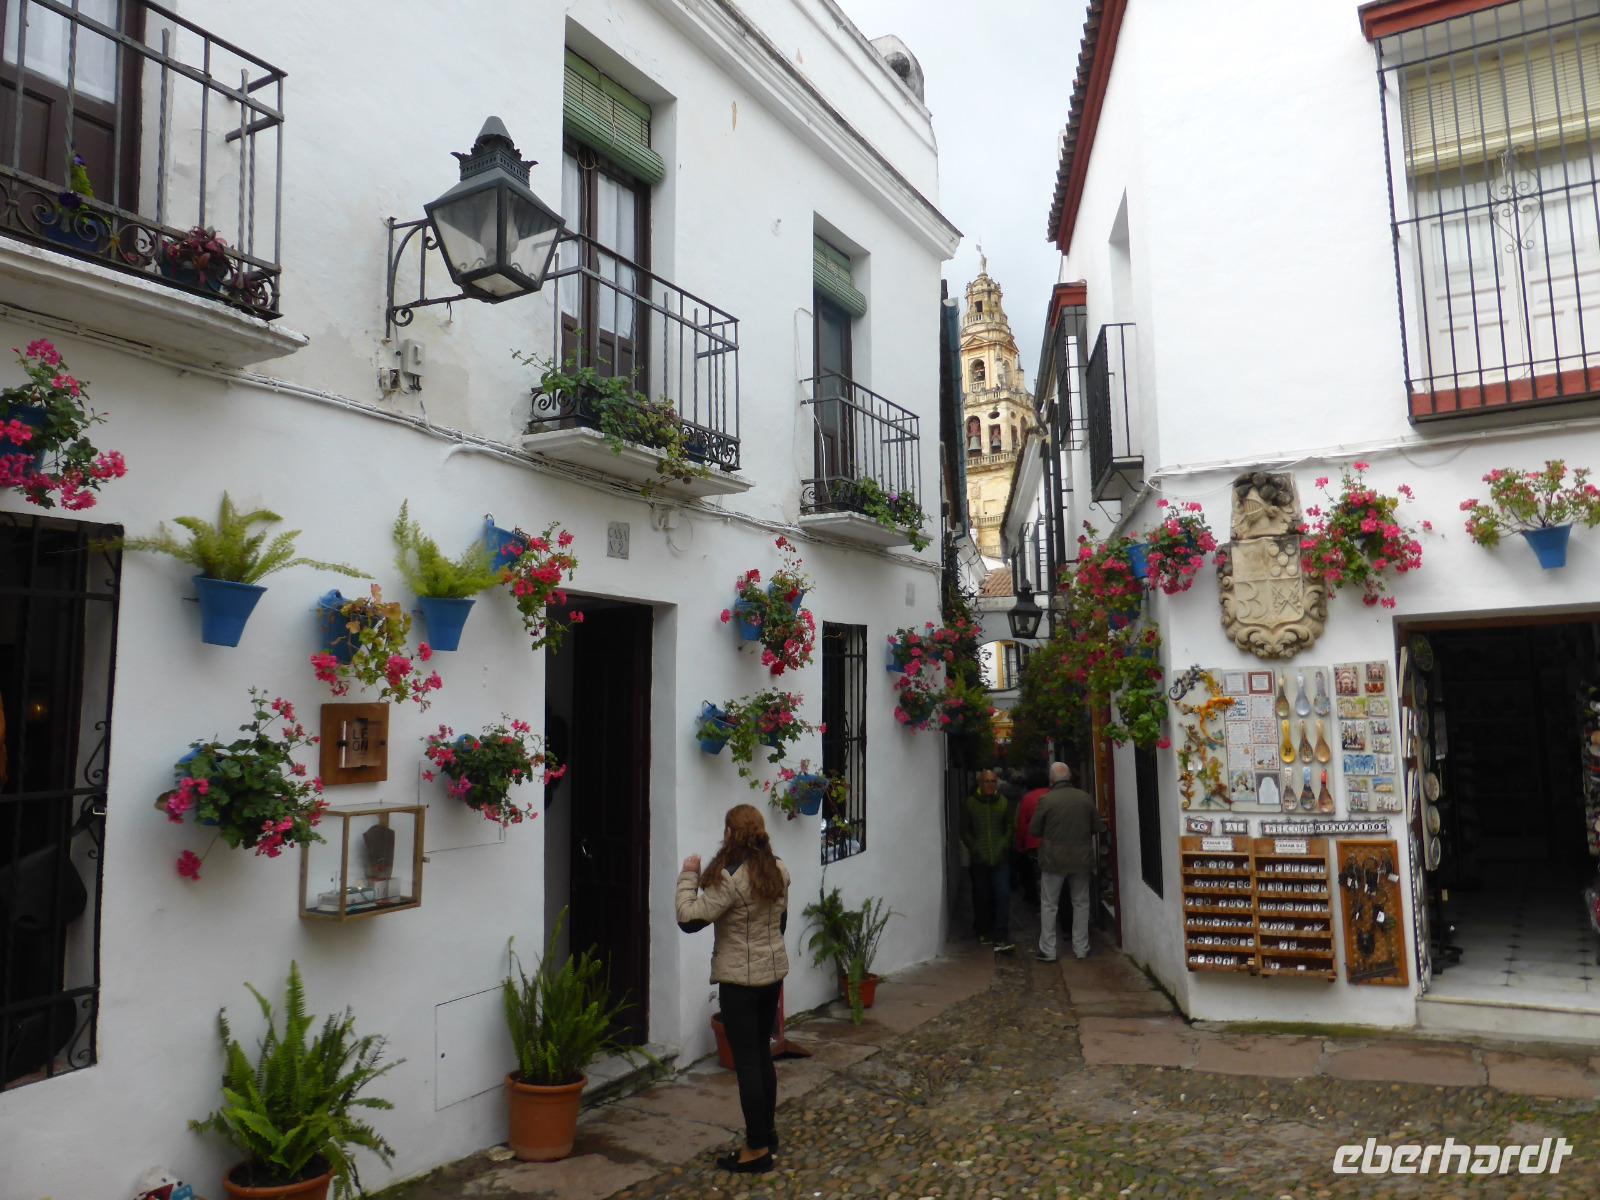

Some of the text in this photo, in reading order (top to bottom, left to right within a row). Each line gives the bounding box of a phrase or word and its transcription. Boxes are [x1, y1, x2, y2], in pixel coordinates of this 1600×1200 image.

[607, 527, 627, 541] CASA
[1268, 825, 1311, 833] WELCOME
[1315, 822, 1386, 831] BIENVENIDOS
